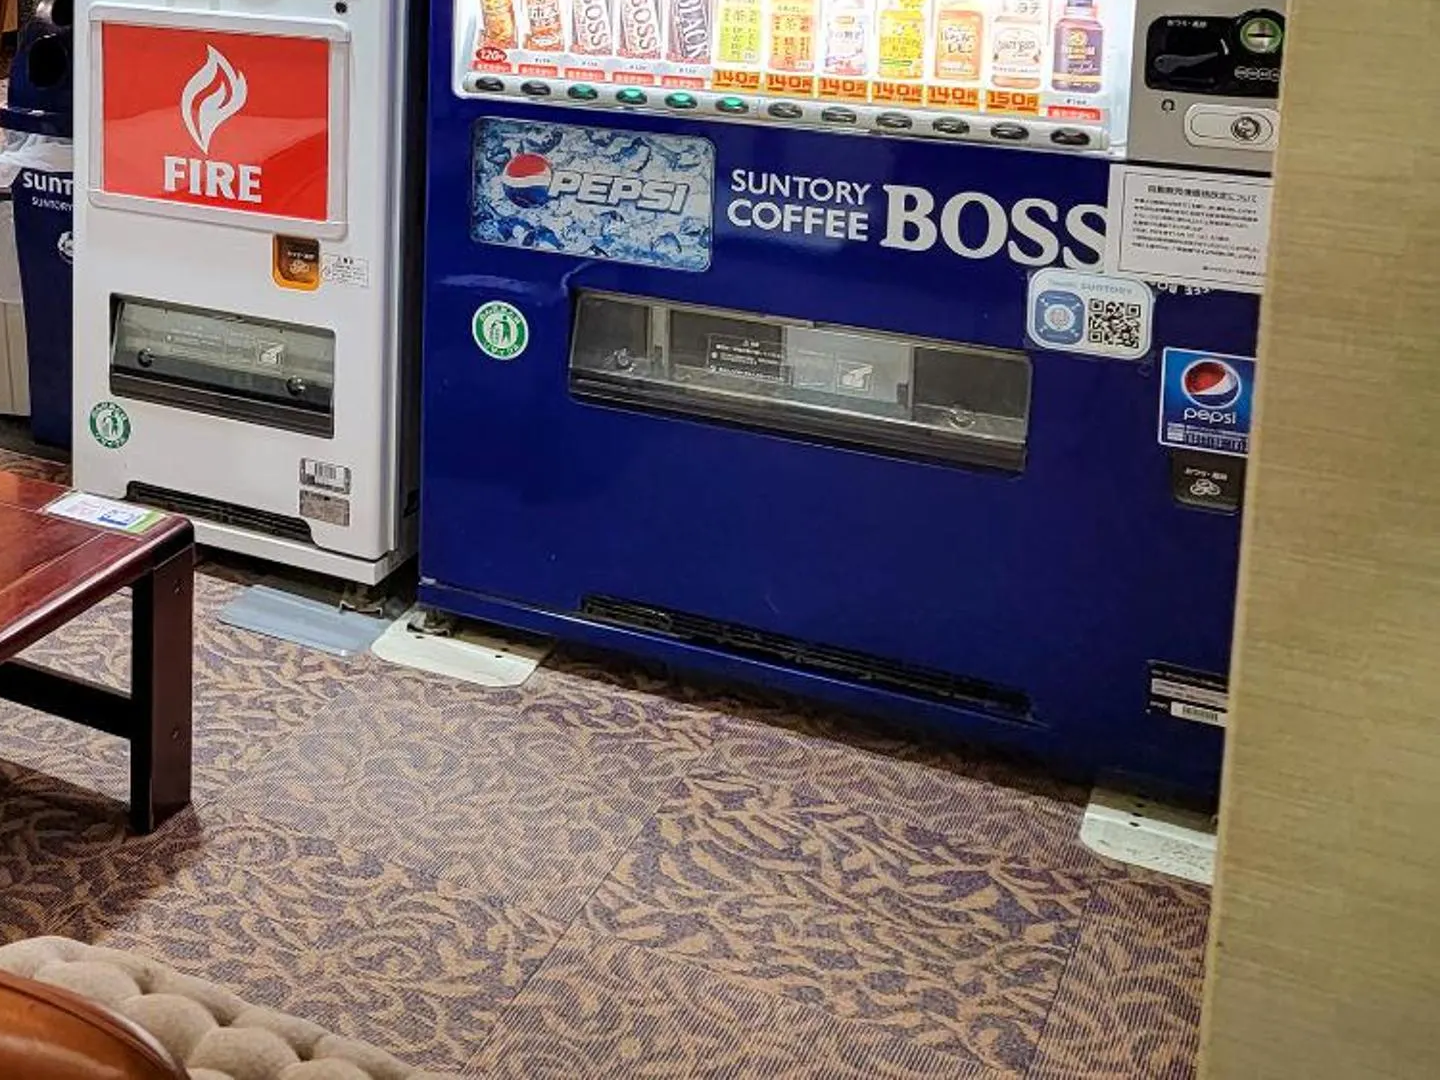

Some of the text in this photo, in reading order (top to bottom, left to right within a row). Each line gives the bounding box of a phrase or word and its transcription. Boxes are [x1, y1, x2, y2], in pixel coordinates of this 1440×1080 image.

[715, 71, 760, 85] 140円
[767, 75, 812, 88] 140円
[821, 79, 866, 93] 140円
[873, 82, 922, 96] 140円
[928, 87, 978, 101] 140円
[989, 91, 1039, 106] 150円
[163, 155, 263, 204] FIRE
[548, 169, 691, 215] PEPSI
[727, 198, 870, 242] COFFEE
[731, 169, 871, 206] SUNTORY
[880, 183, 1109, 272] BOSS
[1183, 406, 1237, 425] pepsi
